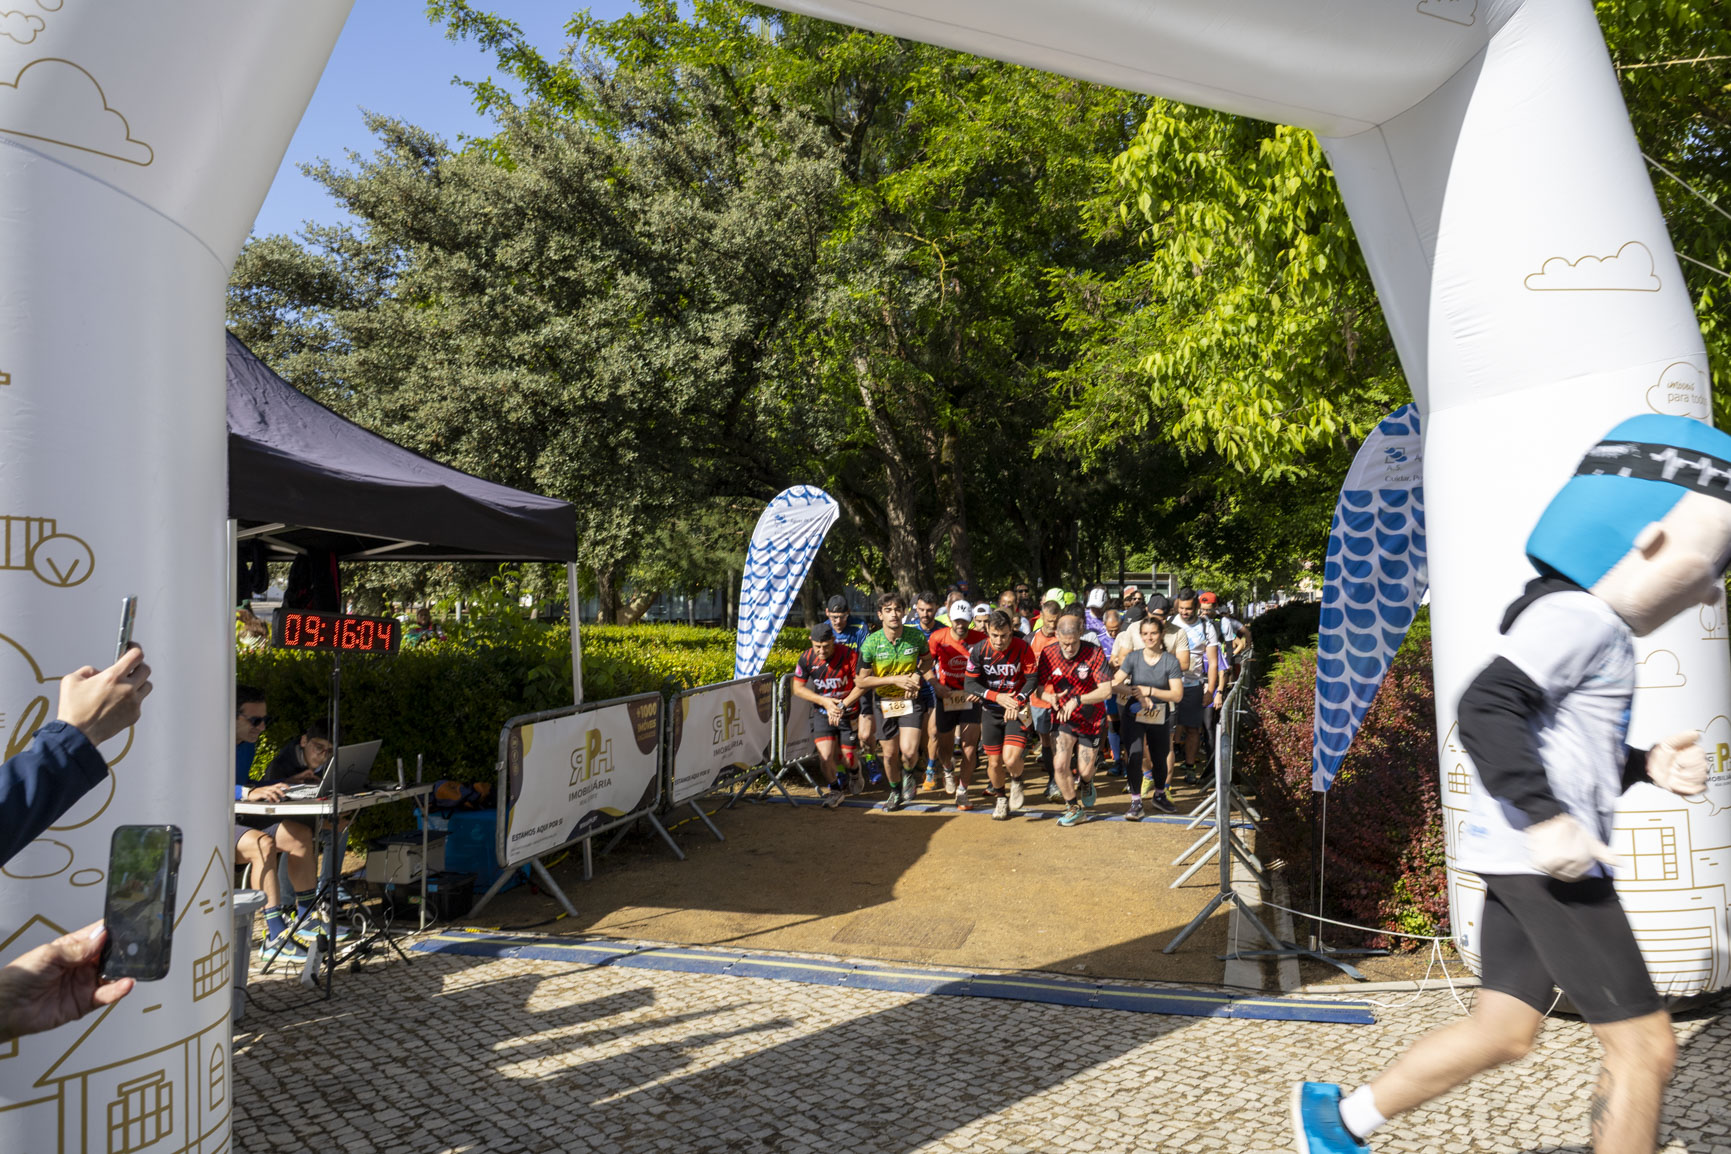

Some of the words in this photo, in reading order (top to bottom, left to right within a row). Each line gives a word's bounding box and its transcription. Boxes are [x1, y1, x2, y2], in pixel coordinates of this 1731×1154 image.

[1668, 393, 1689, 403] para
[284, 613, 391, 651] 09:16:04
[511, 827, 536, 843] ESTAMOS
